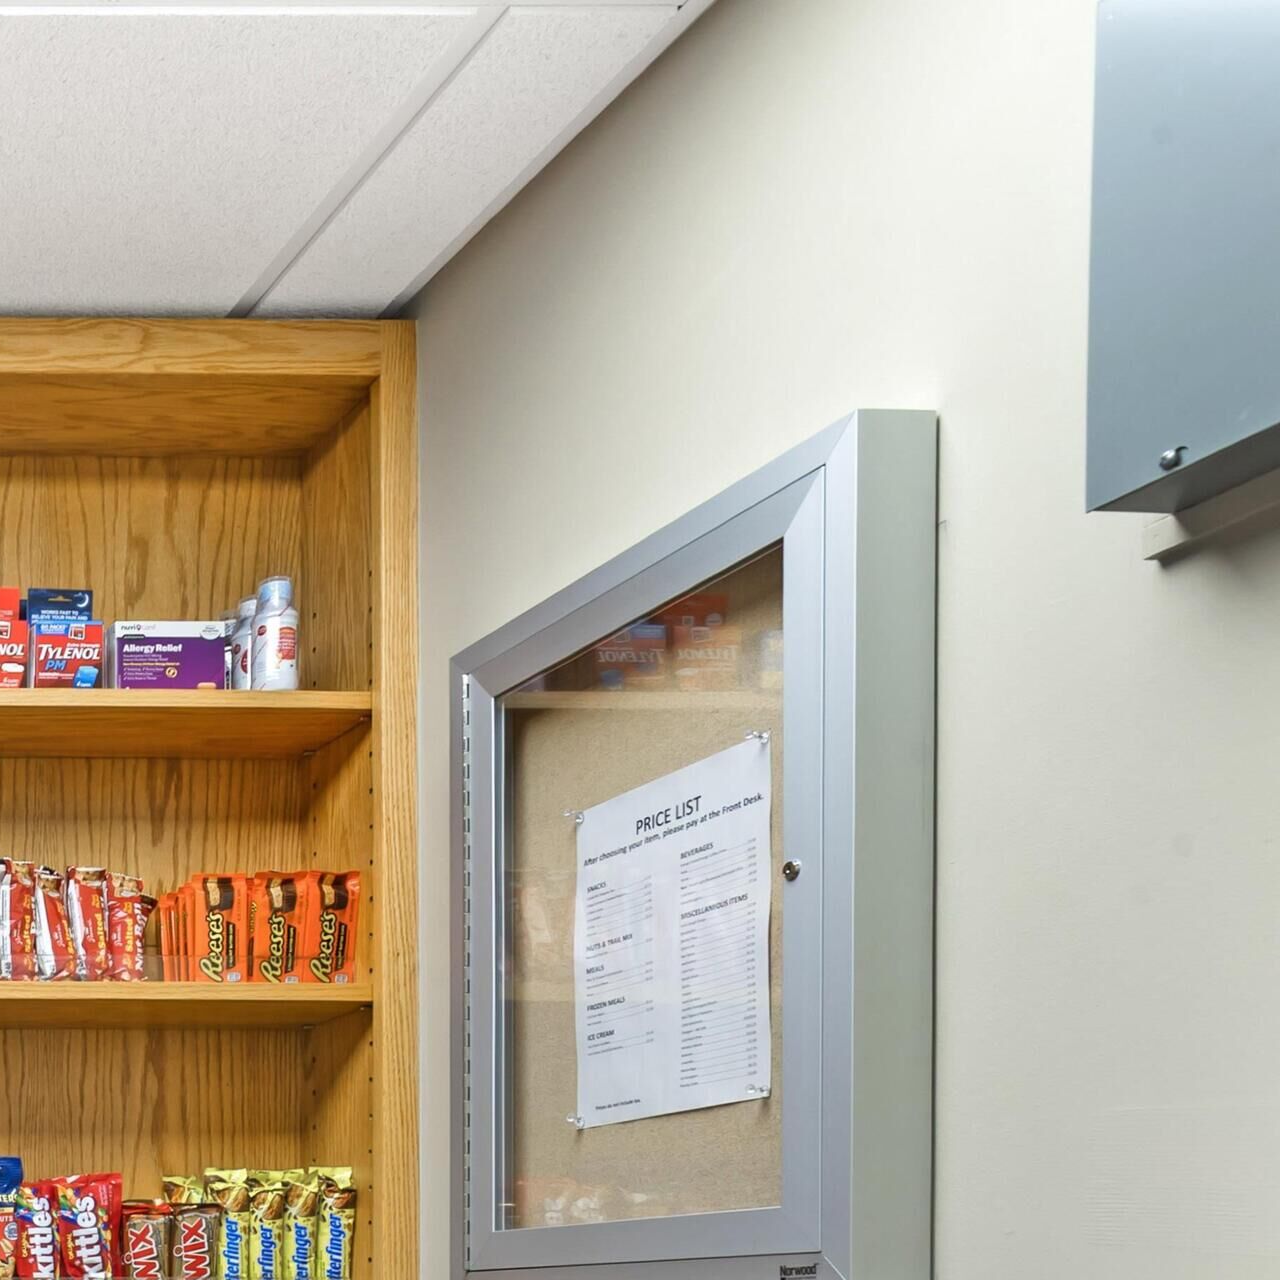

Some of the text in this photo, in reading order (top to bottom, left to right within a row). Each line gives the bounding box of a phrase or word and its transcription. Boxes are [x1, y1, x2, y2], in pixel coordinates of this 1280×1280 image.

[37, 643, 101, 661] TYLENOL
[123, 643, 182, 654] Allergy Relief
[45, 660, 67, 671] PM
[635, 795, 702, 836] PRICE LIST
[583, 856, 599, 867] After
[599, 846, 627, 863] choosing
[628, 839, 643, 853] your
[662, 825, 684, 839] please
[685, 819, 698, 831] pay
[708, 809, 721, 820] the
[722, 801, 742, 815] Front
[743, 792, 765, 807] Desk.
[680, 841, 714, 860] BEVERAGES
[586, 999, 607, 1012] FROZEN
